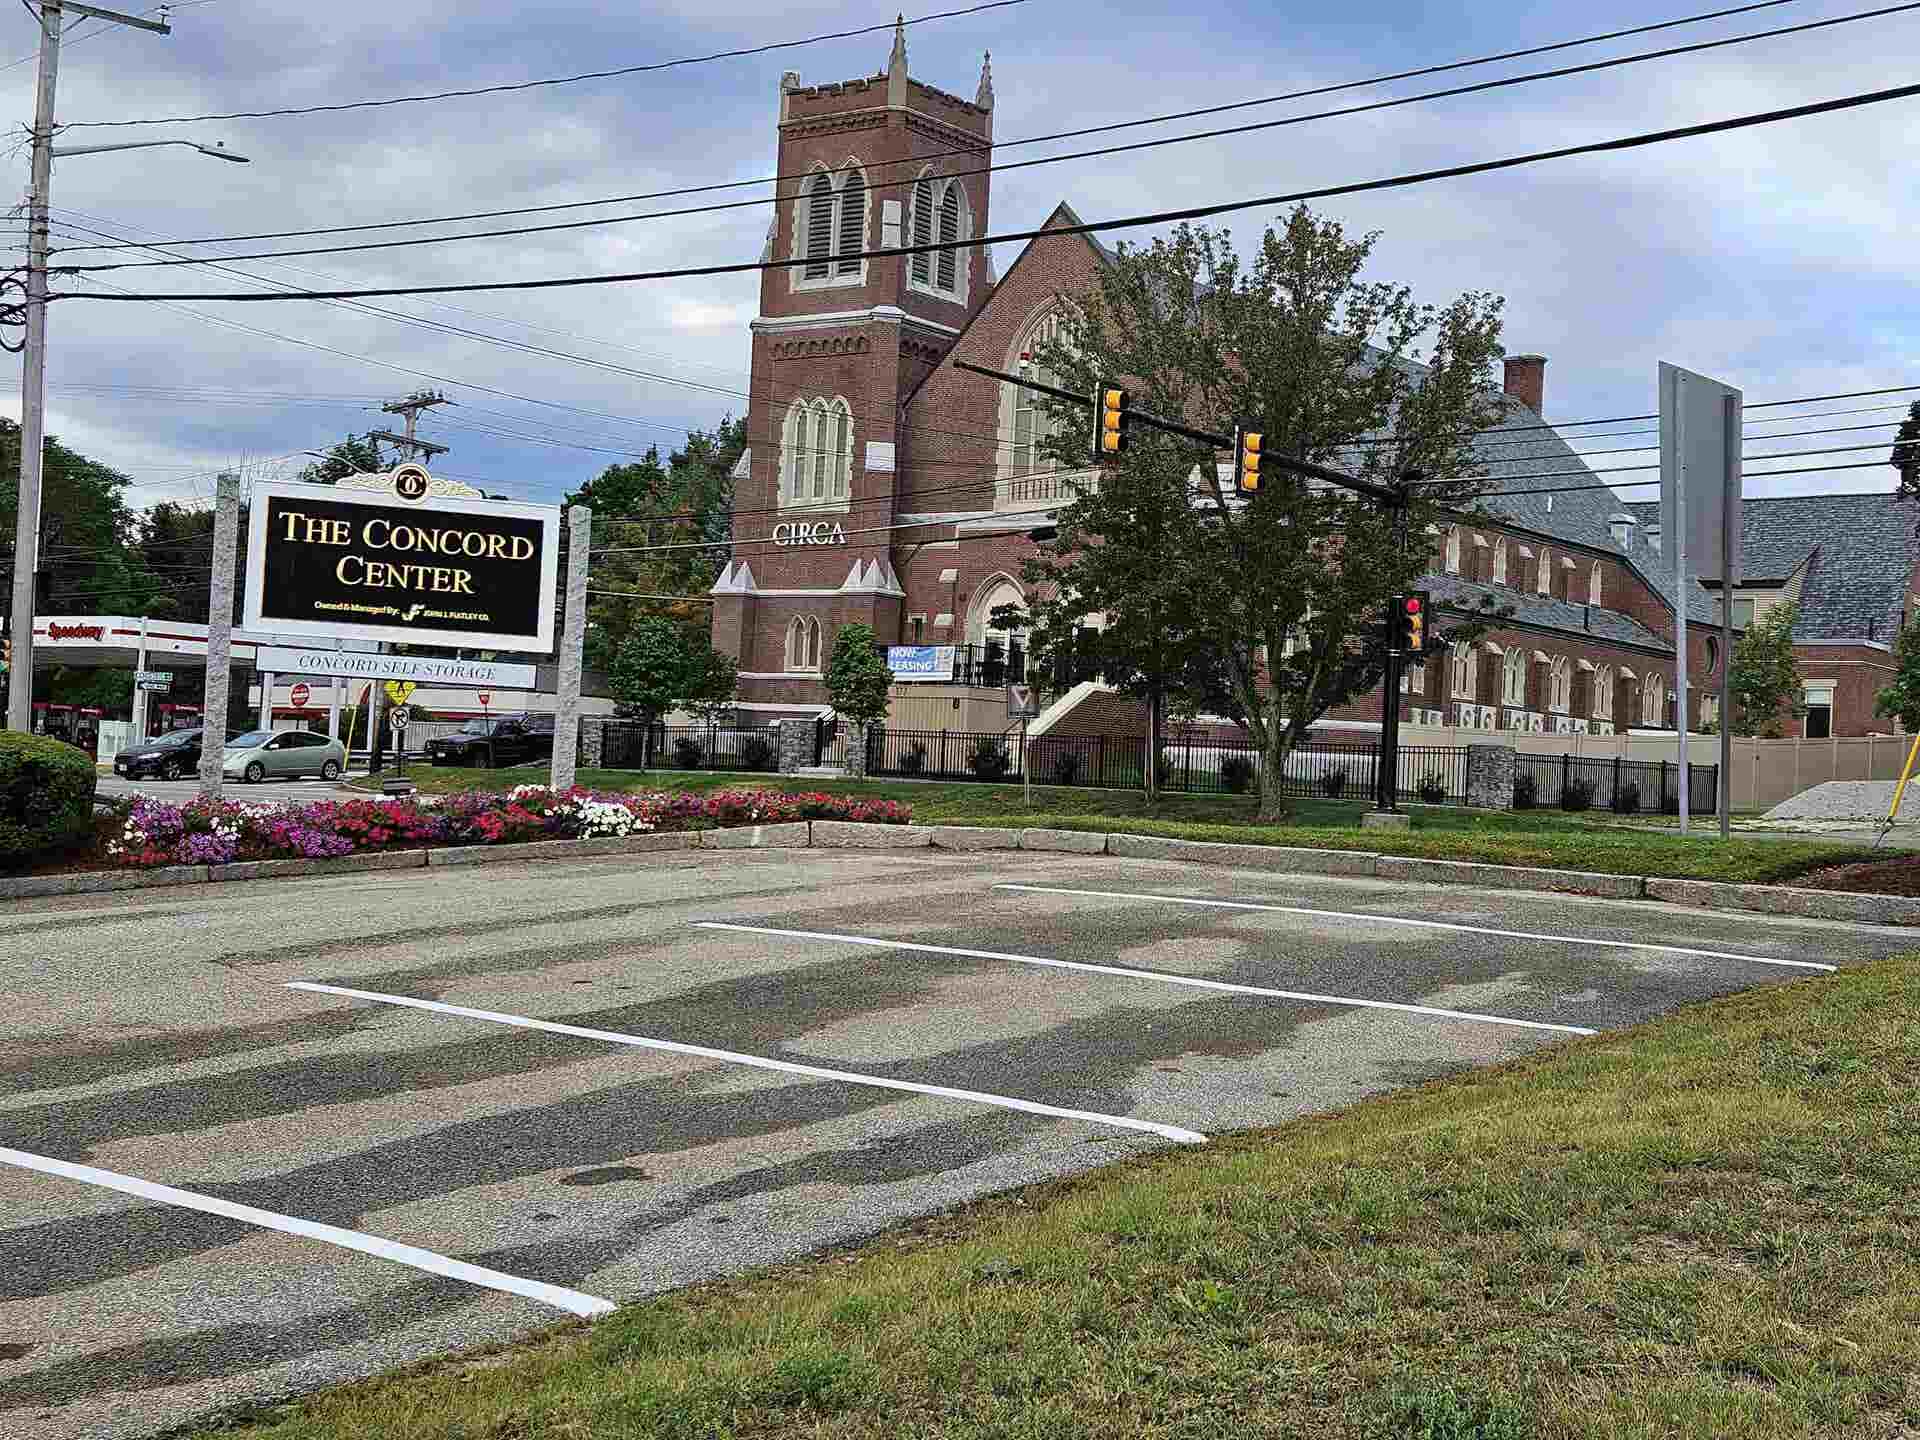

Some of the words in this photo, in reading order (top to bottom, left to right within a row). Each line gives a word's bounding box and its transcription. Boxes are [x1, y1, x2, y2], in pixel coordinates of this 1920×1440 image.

[278, 511, 352, 546] THE
[362, 519, 535, 561] CONCORD
[772, 521, 847, 545] CIRCA
[336, 554, 476, 594] CENTER
[48, 622, 105, 641] Speedway
[298, 655, 380, 673] CONCORD
[382, 660, 419, 674] SELF
[424, 664, 496, 680] STORAGE
[887, 660, 935, 672] LEASING
